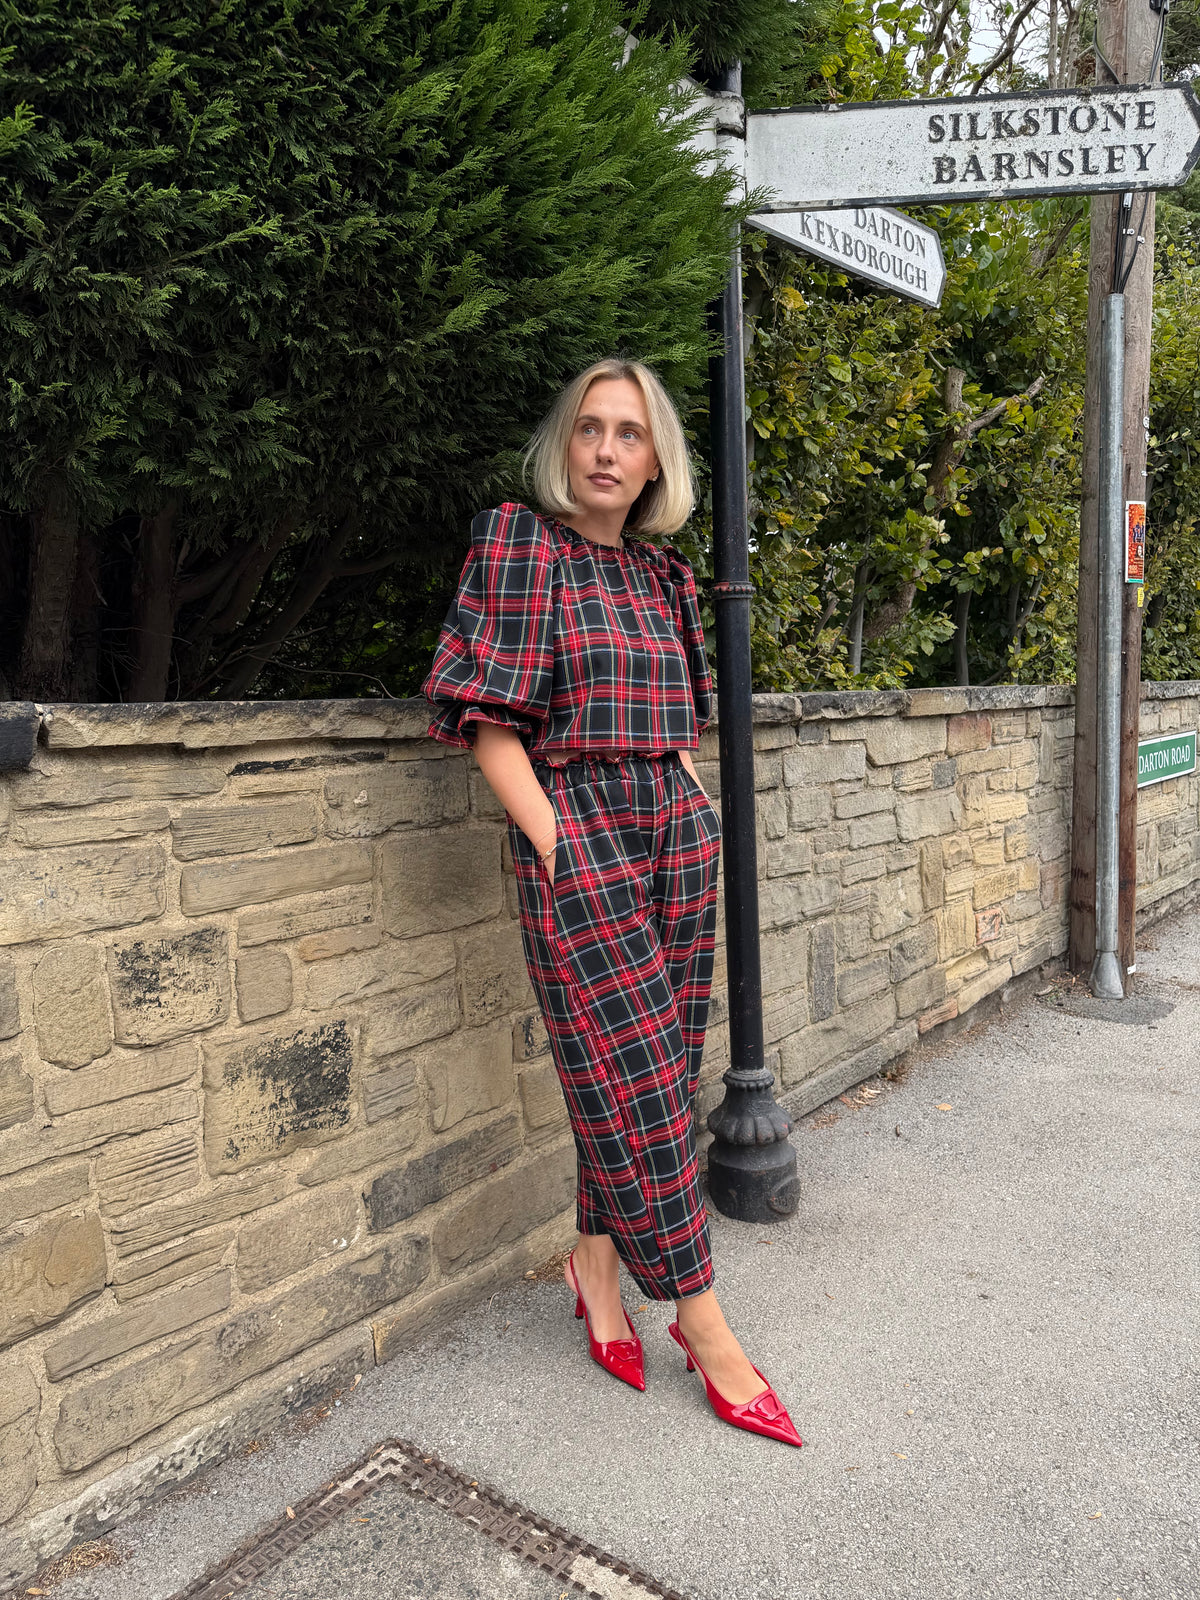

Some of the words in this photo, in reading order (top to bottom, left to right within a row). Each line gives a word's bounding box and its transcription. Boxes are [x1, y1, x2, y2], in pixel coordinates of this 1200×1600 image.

[928, 101, 1156, 143] SILKSTONE
[932, 142, 1157, 184] BARNSLEY
[799, 212, 928, 292] KEXBOROUGH
[853, 208, 927, 258] DARTON
[1138, 749, 1169, 774] DARTON
[1171, 744, 1190, 766] ROAD
[422, 1477, 471, 1510] POST
[470, 1503, 533, 1546] OFFICE
